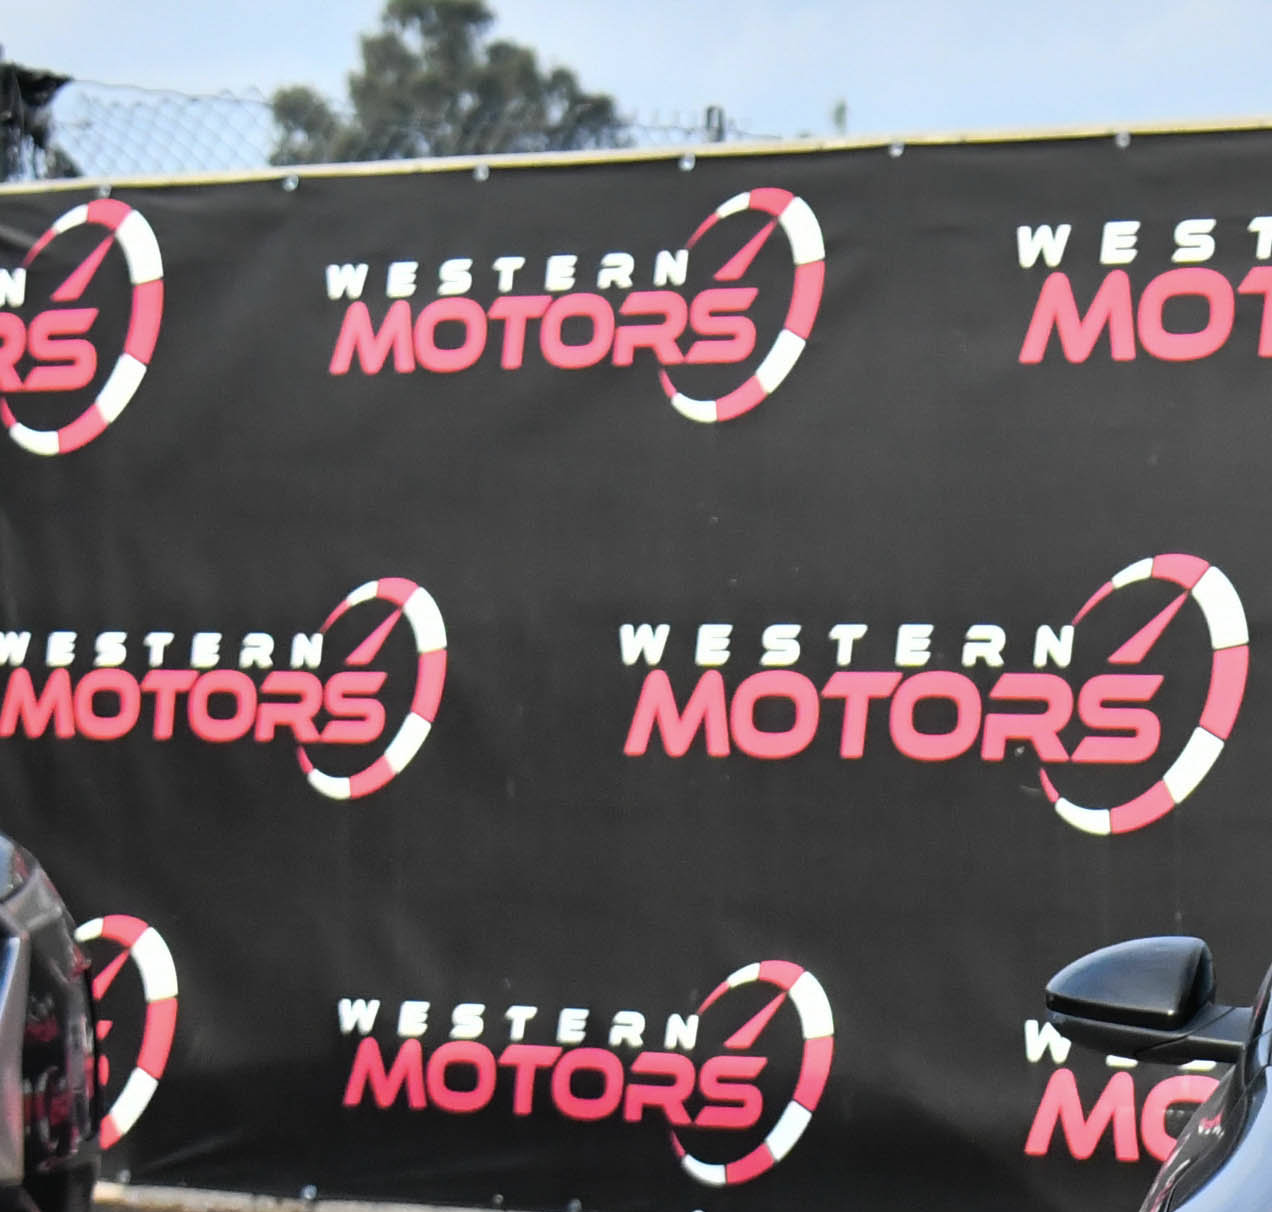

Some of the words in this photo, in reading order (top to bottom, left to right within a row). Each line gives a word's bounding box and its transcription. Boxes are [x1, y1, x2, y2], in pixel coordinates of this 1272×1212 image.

[326, 249, 689, 299] WESTERN
[329, 287, 759, 375] MOTORS
[0, 631, 324, 668] WESTERN
[619, 623, 1075, 668] WESTERN
[0, 666, 388, 744] MOTORS
[623, 669, 1165, 765] MOTORS
[338, 998, 700, 1050] WESTERN
[342, 1036, 768, 1129] MOTORS
